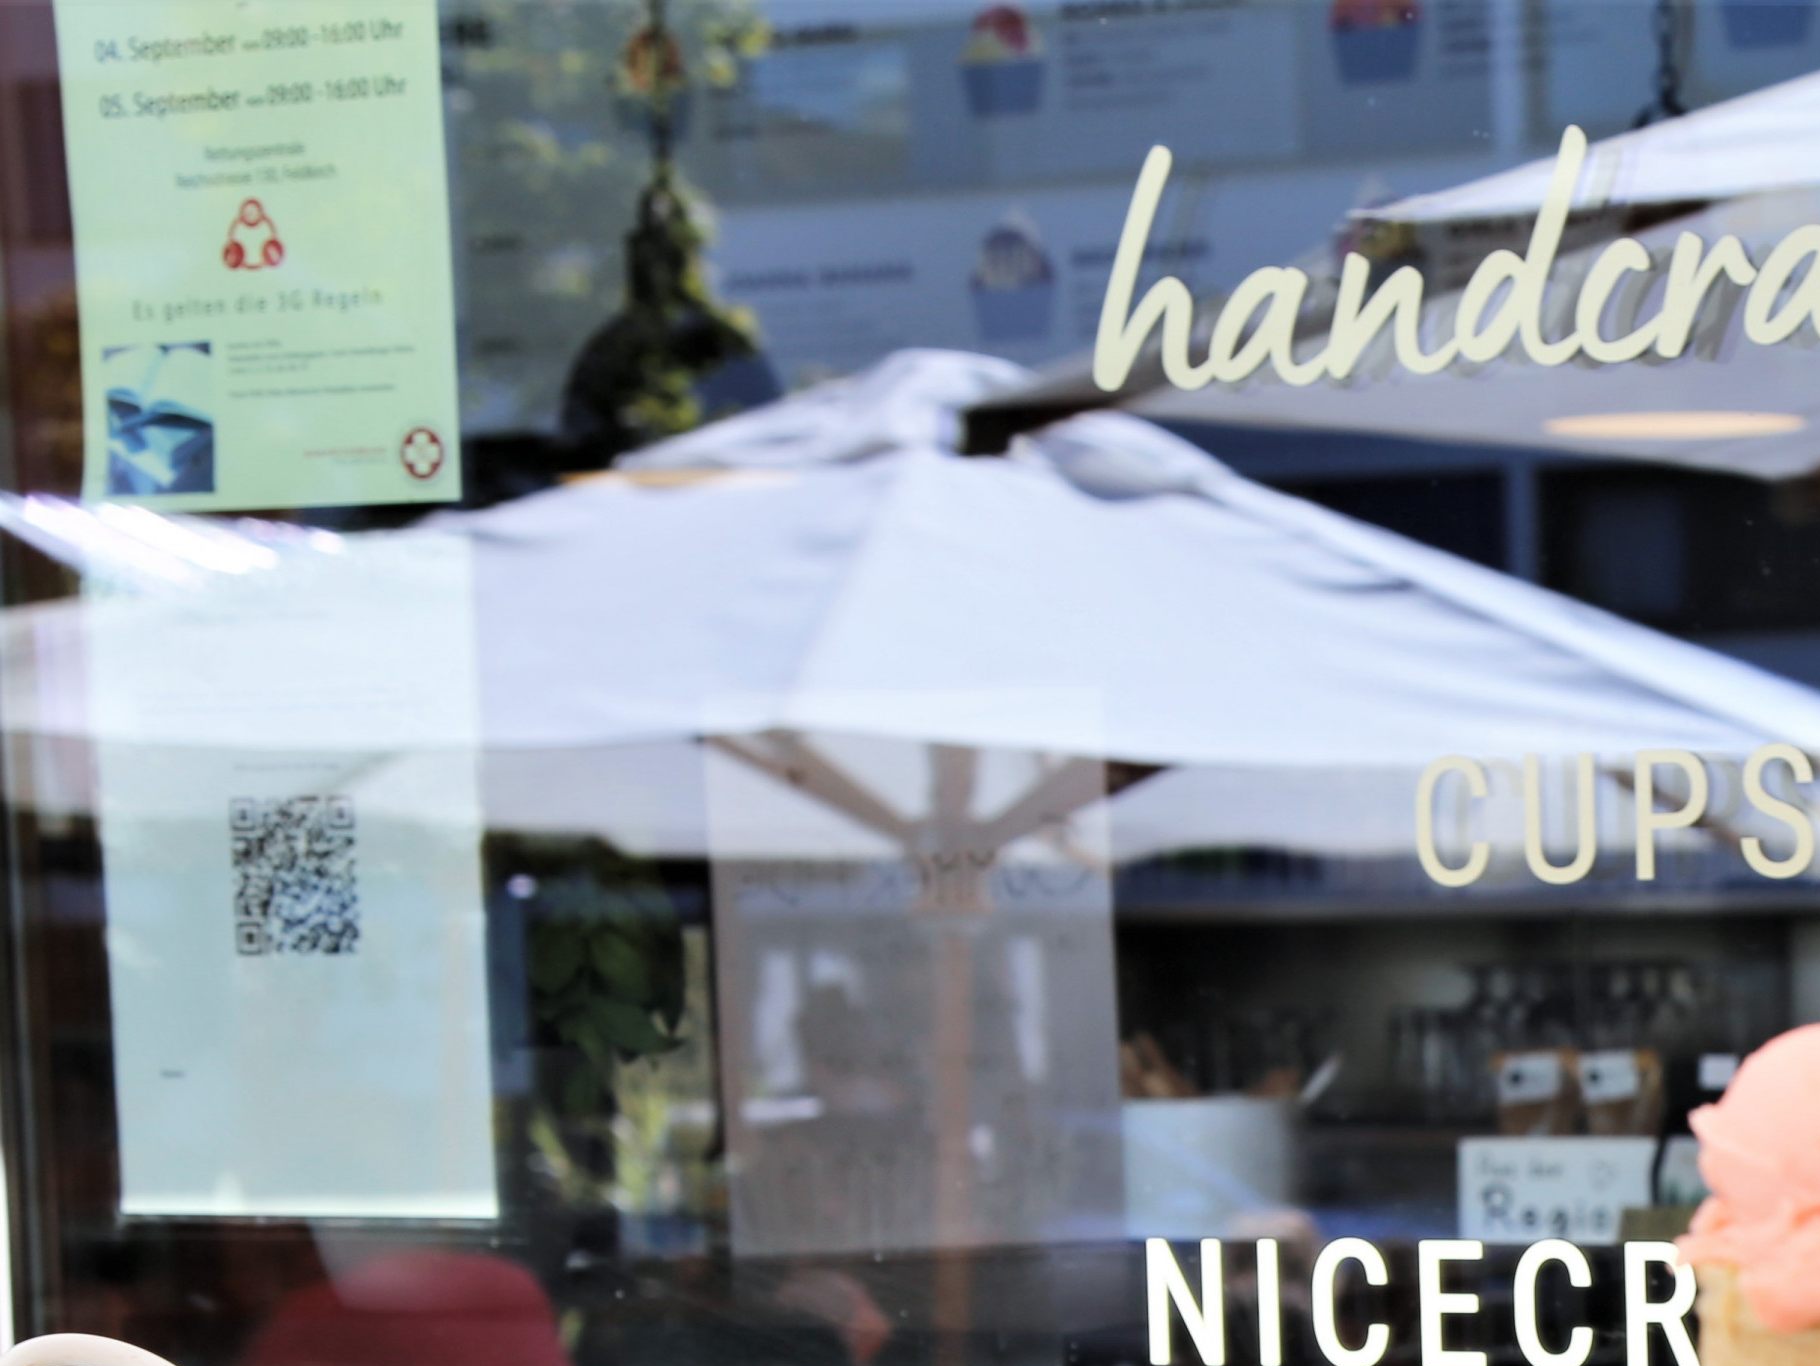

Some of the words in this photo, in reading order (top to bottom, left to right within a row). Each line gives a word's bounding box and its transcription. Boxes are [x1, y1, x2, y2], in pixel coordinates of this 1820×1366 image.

[127, 31, 236, 64] September
[369, 18, 403, 41] Uhr
[132, 86, 241, 120] September
[372, 73, 406, 97] Uhr
[1415, 742, 1815, 888] CUPS
[1480, 1182, 1614, 1237] Regio
